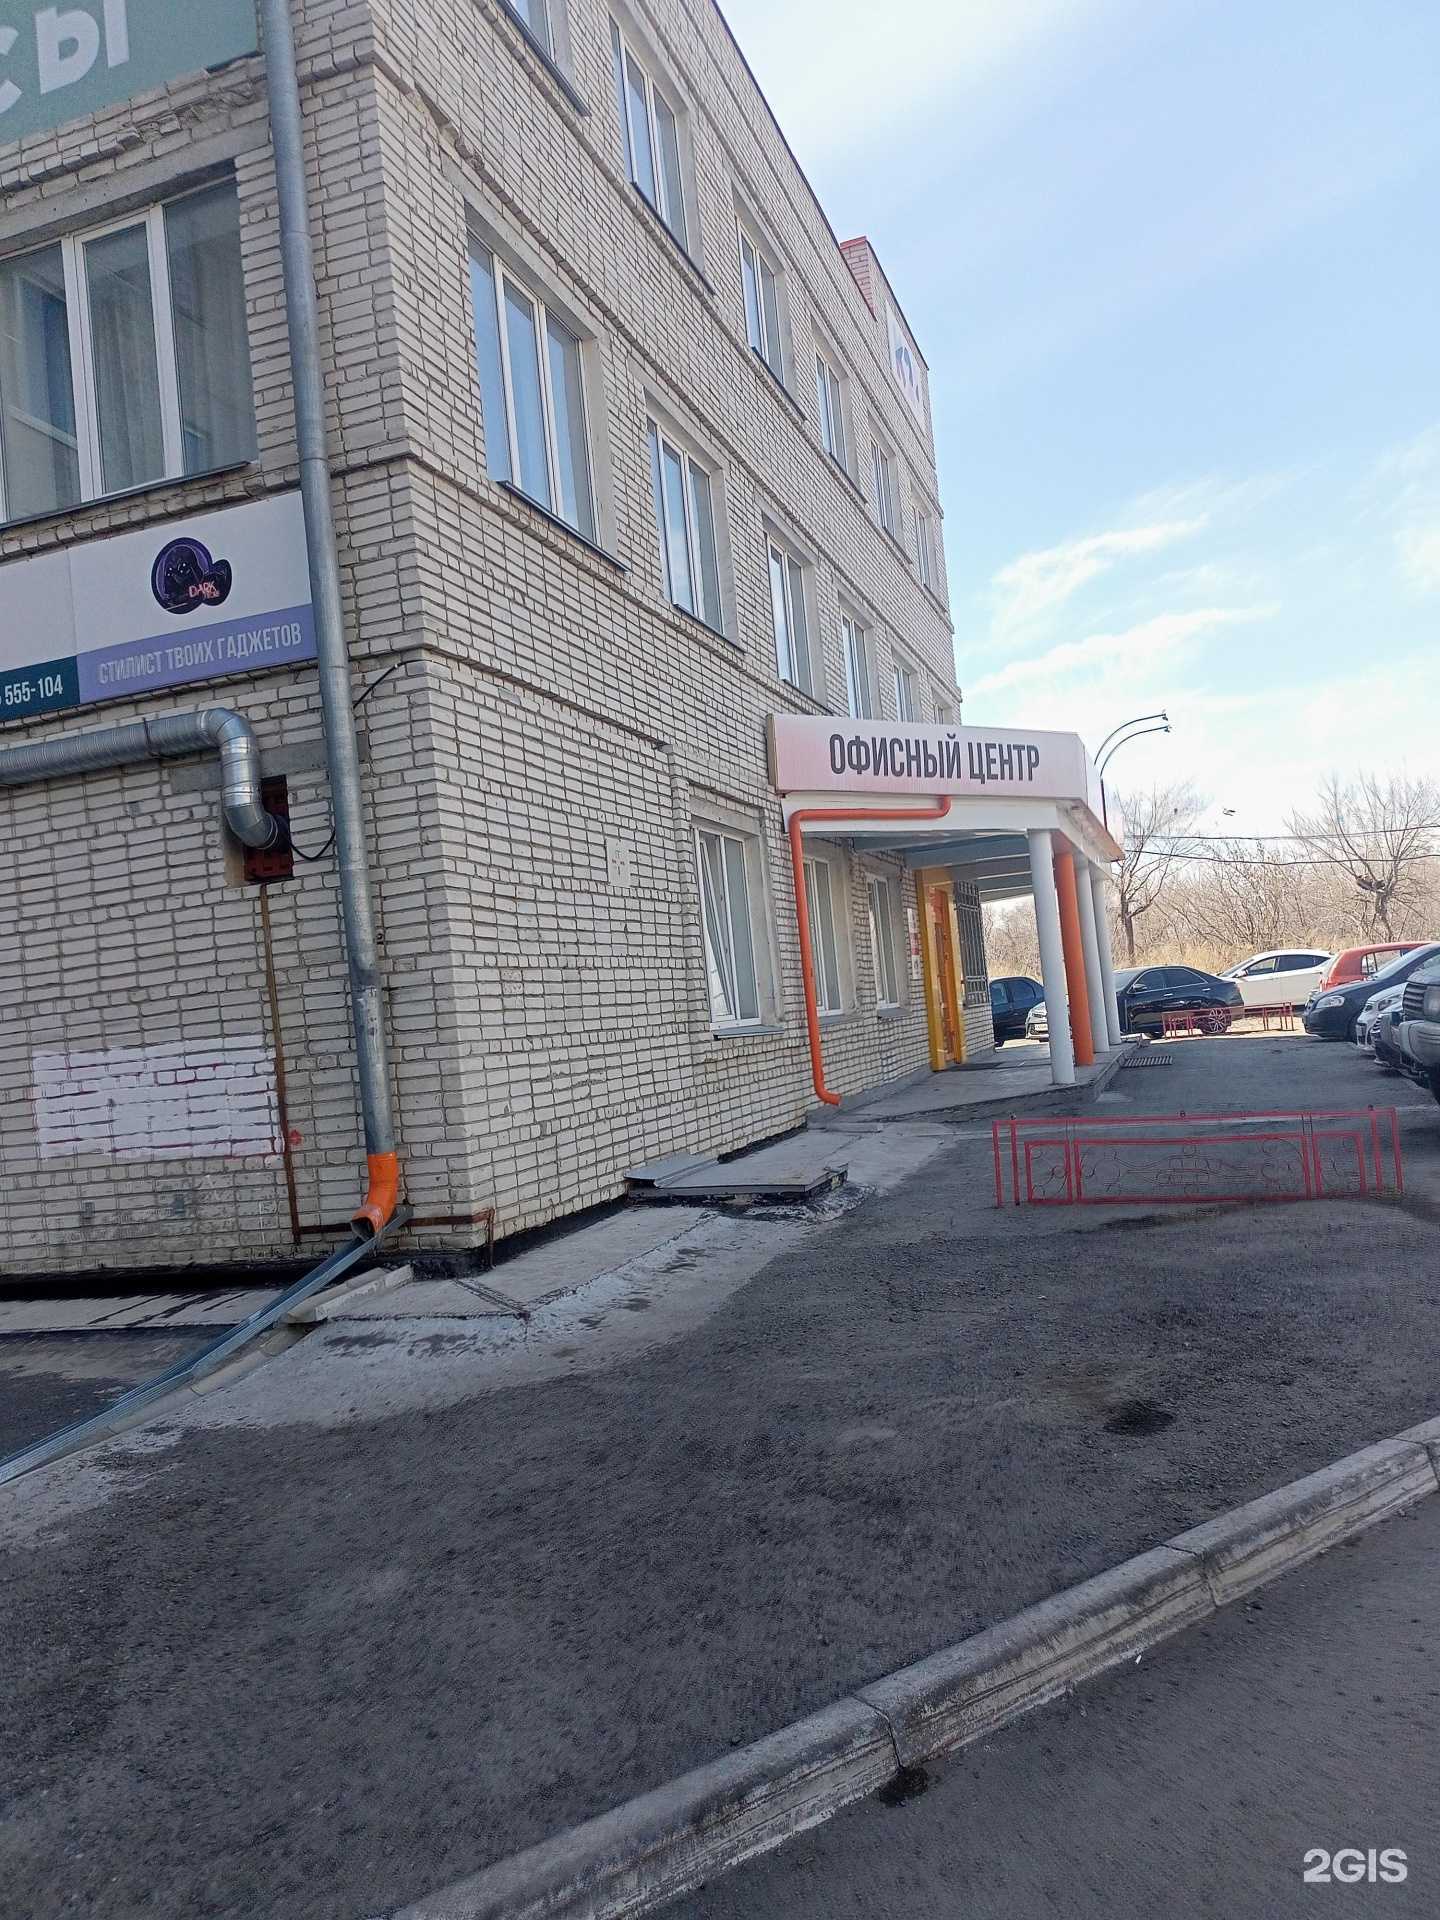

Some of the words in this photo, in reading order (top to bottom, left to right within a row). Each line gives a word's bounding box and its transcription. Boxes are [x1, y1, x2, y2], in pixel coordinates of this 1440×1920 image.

[99, 651, 162, 685] СТИЛИСТ
[165, 640, 214, 671] ТВОИХ
[217, 622, 302, 661] ГАДЖЕТОВ
[4, 674, 64, 705] 555-104
[829, 733, 961, 779] ОФИСНЫЙ
[968, 742, 1040, 785] ЦЕНТР
